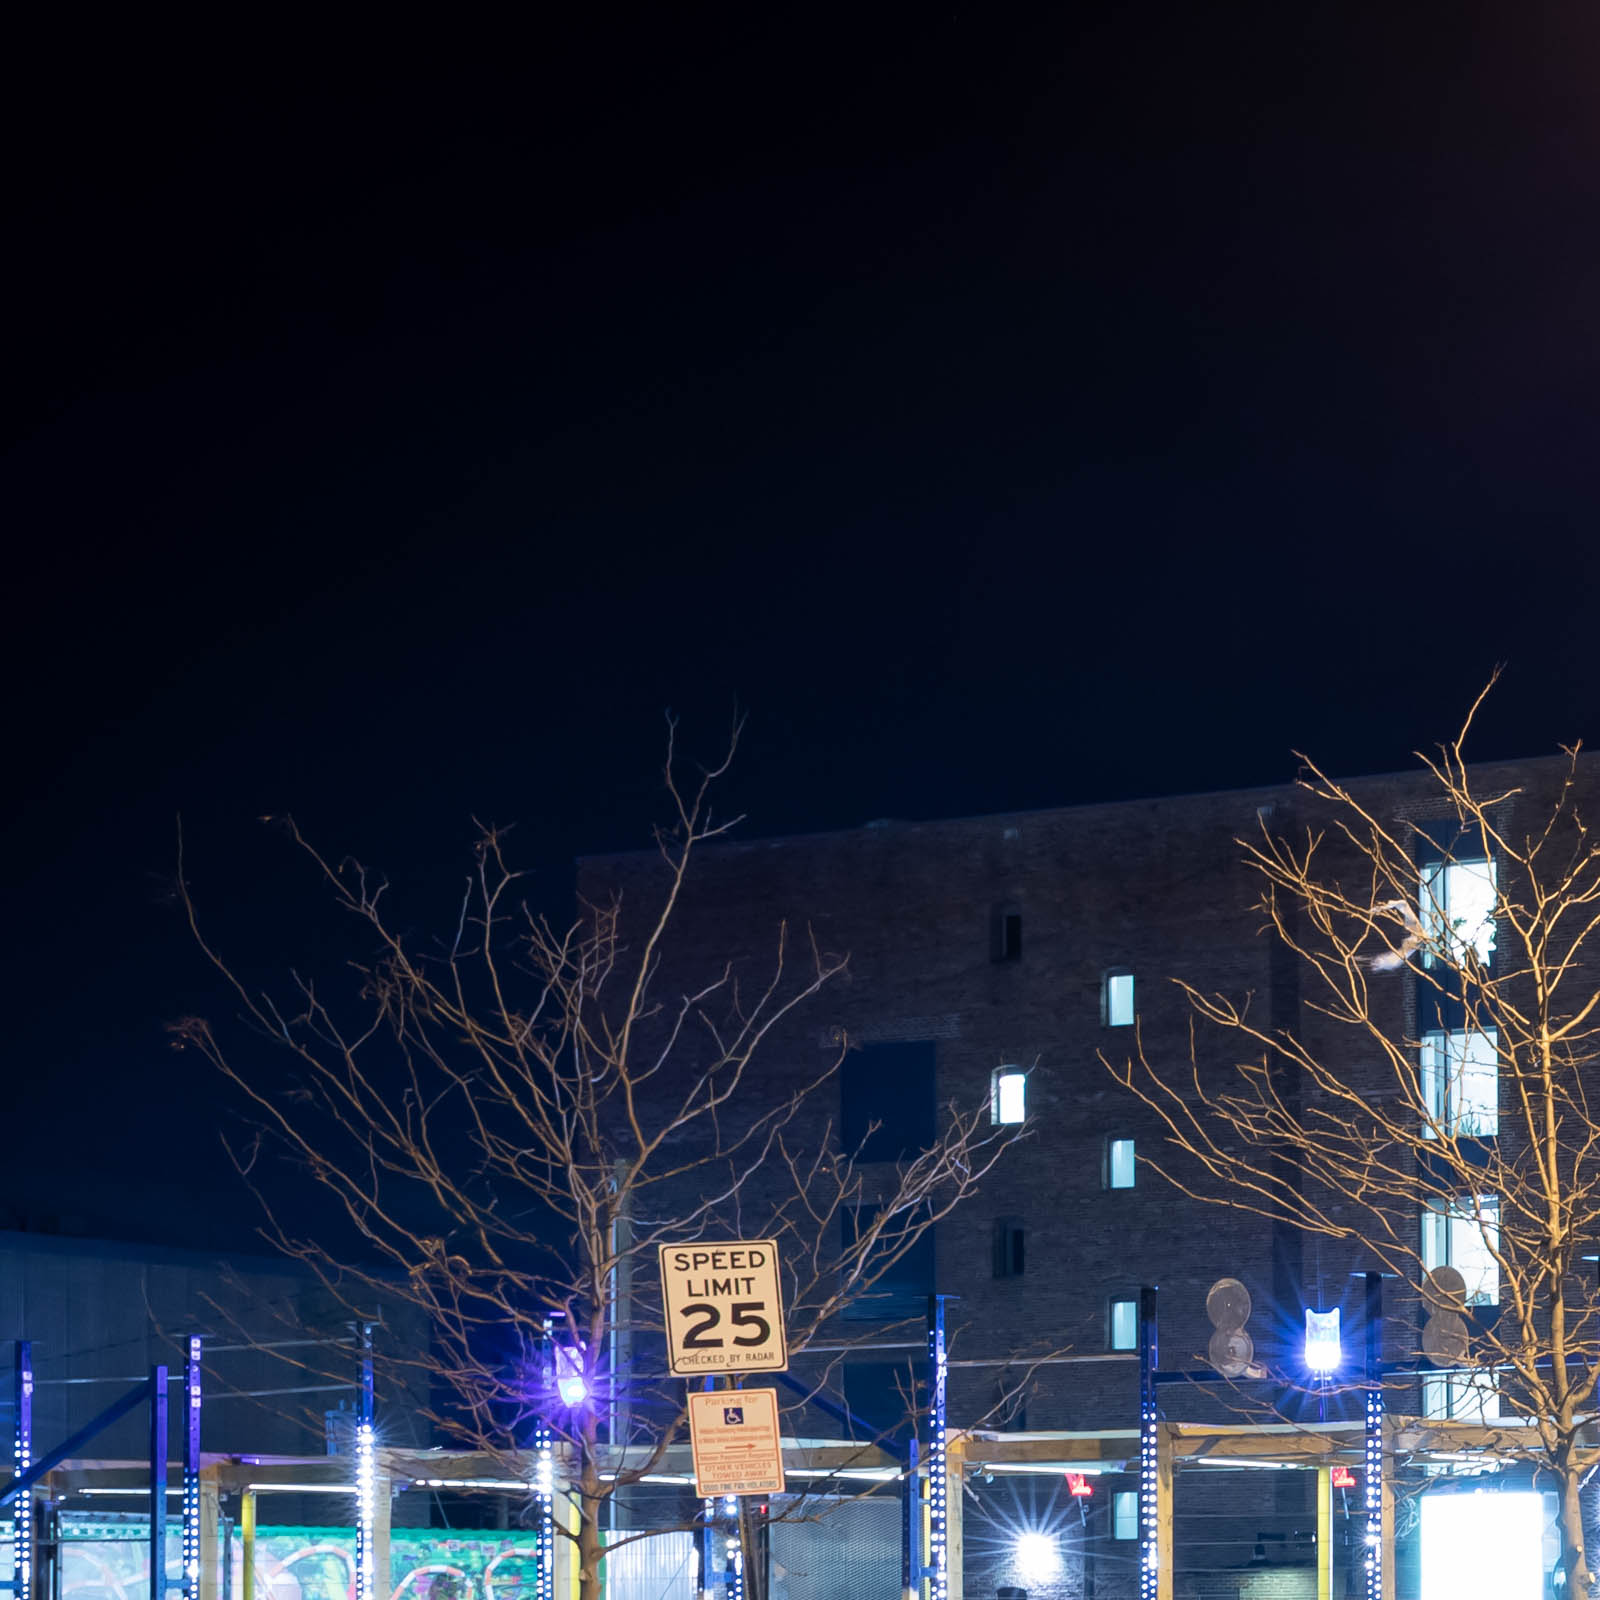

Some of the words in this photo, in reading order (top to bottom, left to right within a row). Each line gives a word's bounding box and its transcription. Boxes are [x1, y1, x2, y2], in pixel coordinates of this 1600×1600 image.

[674, 1251, 765, 1271] SPEED
[687, 1277, 755, 1297] LIMIT
[680, 1302, 770, 1349] 25
[682, 1353, 724, 1366] CHECKED
[730, 1353, 741, 1364] BY
[746, 1351, 774, 1361] RADAR
